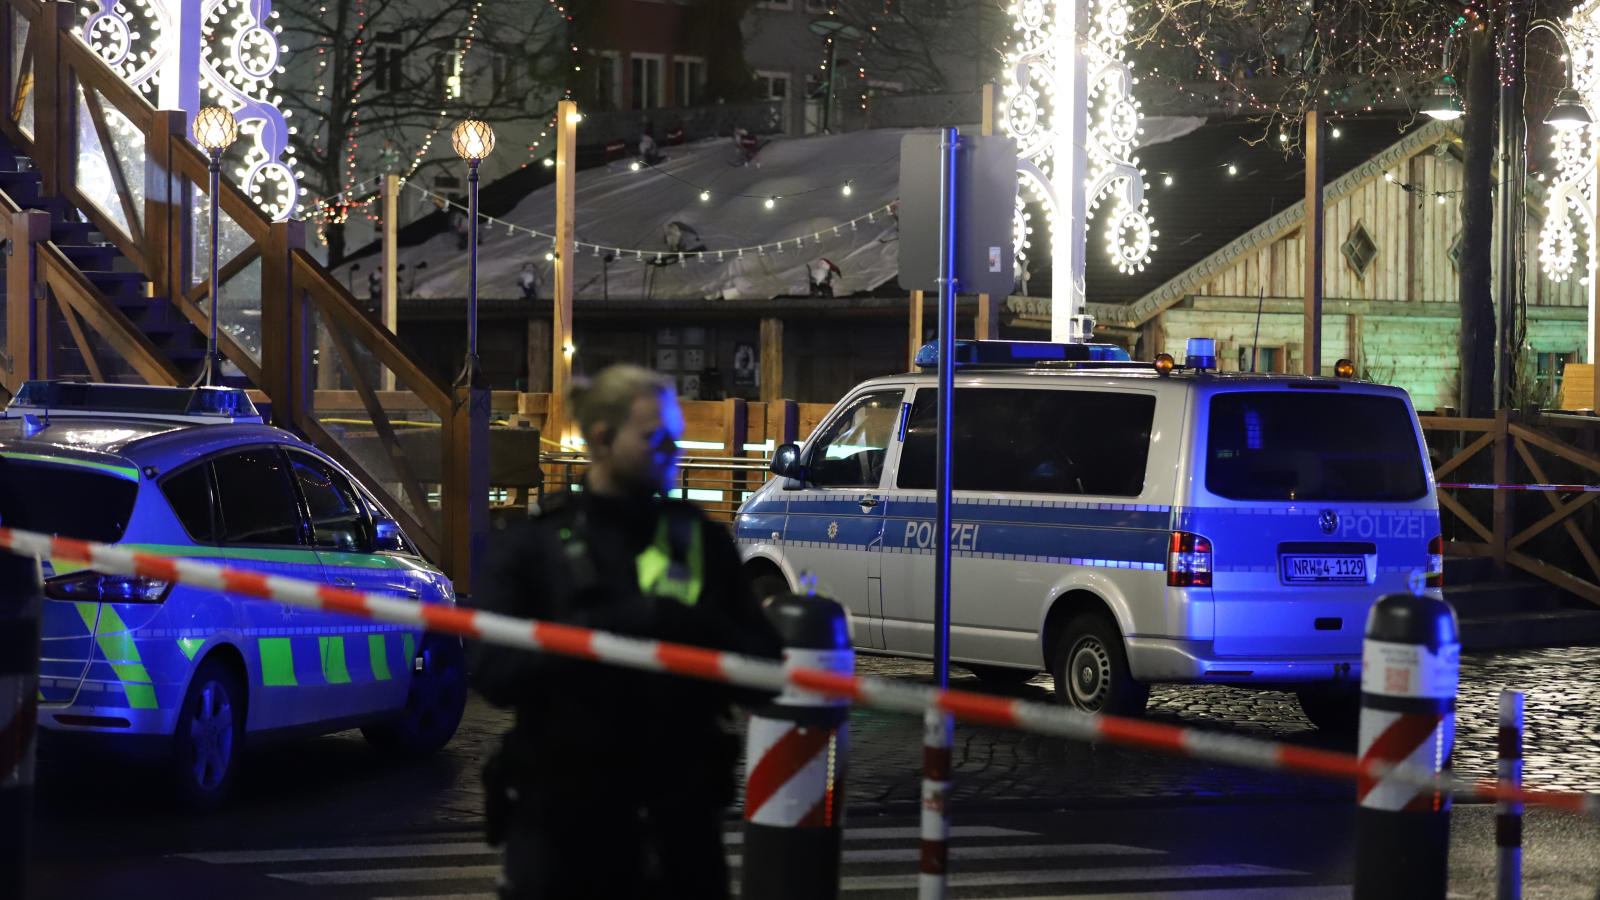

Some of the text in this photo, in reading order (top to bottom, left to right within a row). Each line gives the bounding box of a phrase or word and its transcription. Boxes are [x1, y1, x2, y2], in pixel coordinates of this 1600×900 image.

[904, 521, 979, 551] POLZEI
[1342, 515, 1425, 539] POLIZEI
[1294, 559, 1364, 575] NRW 4-1129
